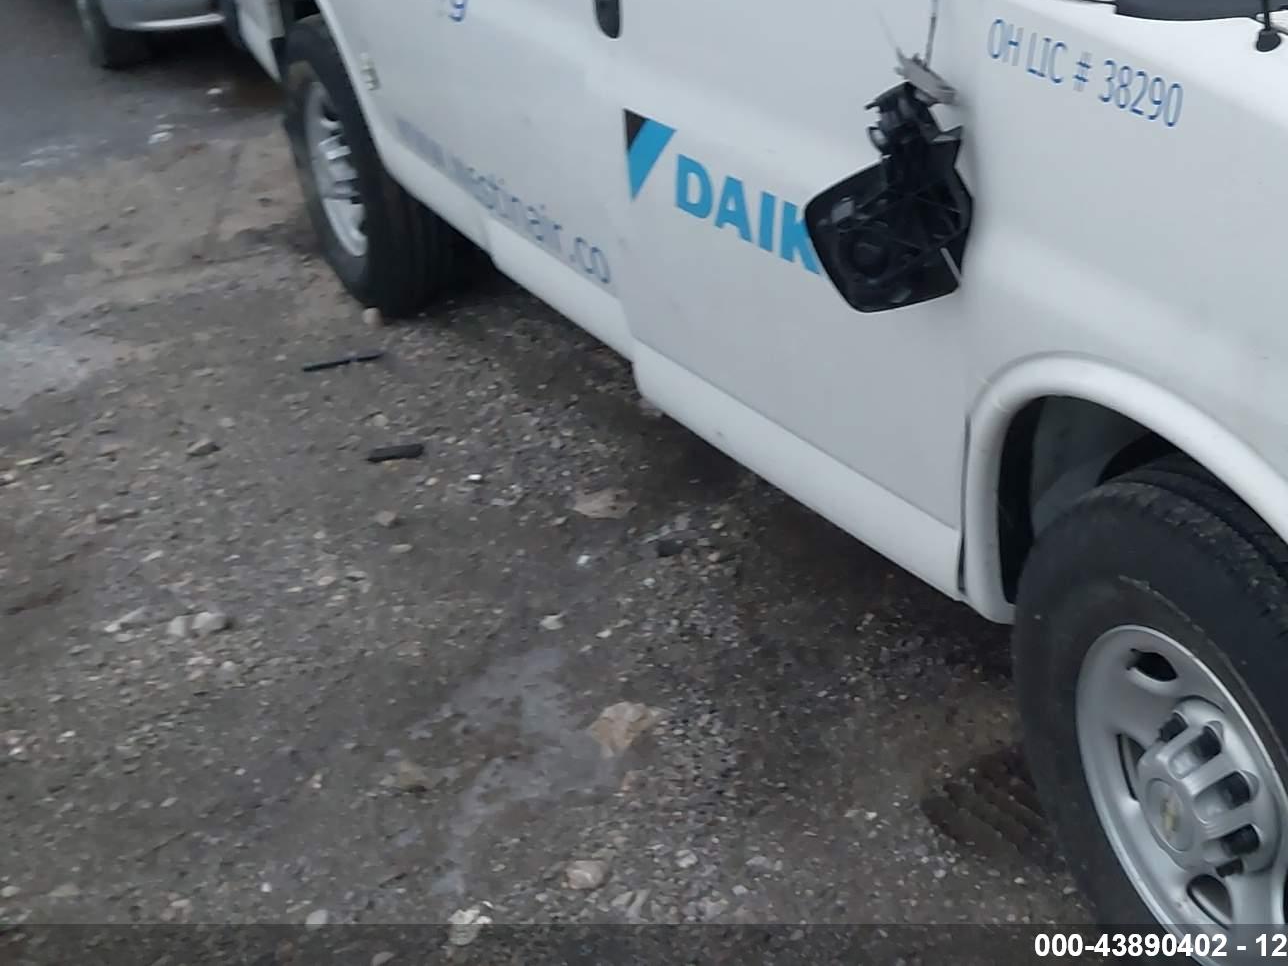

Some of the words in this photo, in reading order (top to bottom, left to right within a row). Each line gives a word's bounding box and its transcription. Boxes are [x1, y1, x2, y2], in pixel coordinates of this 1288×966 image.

[987, 18, 1024, 67] OH
[1026, 32, 1069, 84] LIC
[1072, 51, 1093, 93] #
[1098, 59, 1184, 128] 38290
